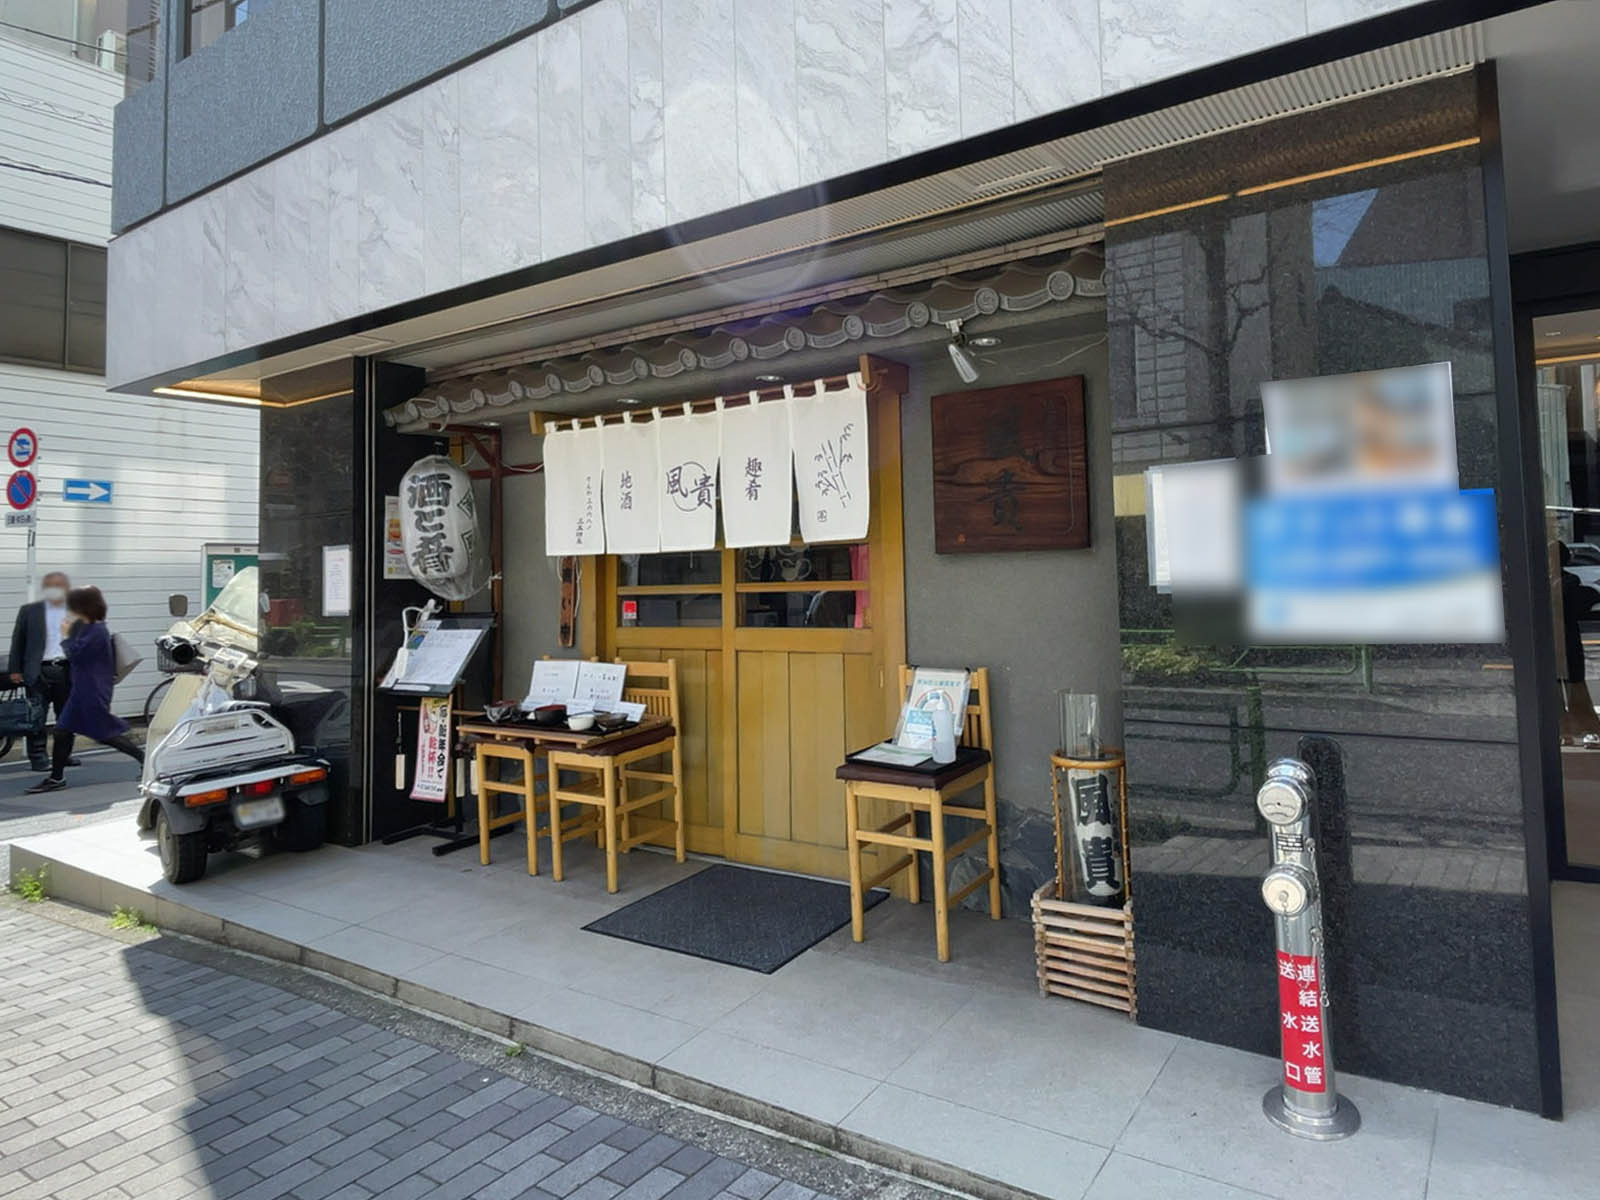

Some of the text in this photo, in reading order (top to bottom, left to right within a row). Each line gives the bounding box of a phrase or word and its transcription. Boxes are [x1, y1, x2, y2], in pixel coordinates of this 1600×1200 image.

[620, 471, 633, 510] 地酒
[1279, 960, 1302, 1082] 送水口
[1297, 963, 1322, 1085] 連結送水管
